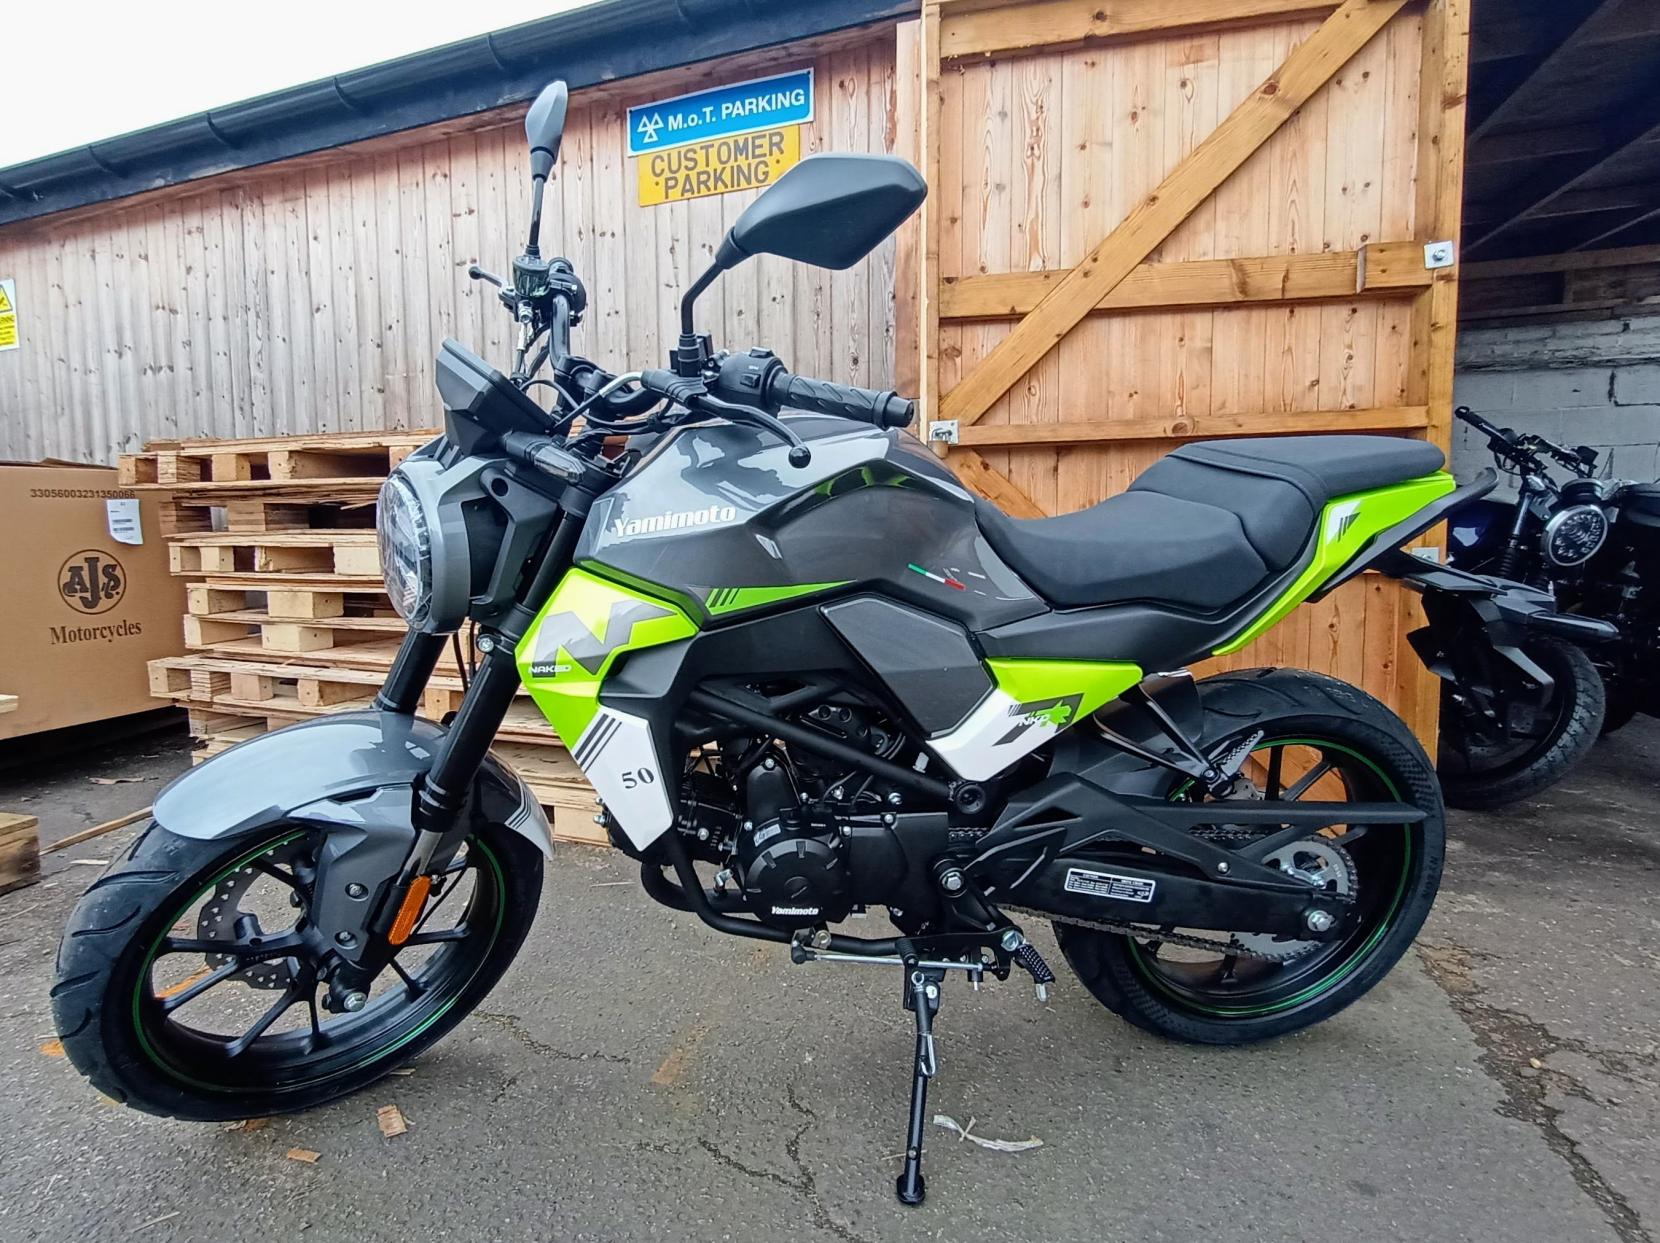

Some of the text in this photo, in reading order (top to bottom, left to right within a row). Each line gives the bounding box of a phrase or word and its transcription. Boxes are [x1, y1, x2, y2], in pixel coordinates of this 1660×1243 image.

[668, 89, 805, 132] M.o.T. PARKING
[651, 131, 785, 178] CUSTOMER
[664, 160, 770, 200] PARKING
[614, 504, 736, 538] Yamimoto
[49, 619, 142, 645] Motorcycles
[622, 767, 655, 790] 50
[771, 905, 819, 916] Yamimoto
